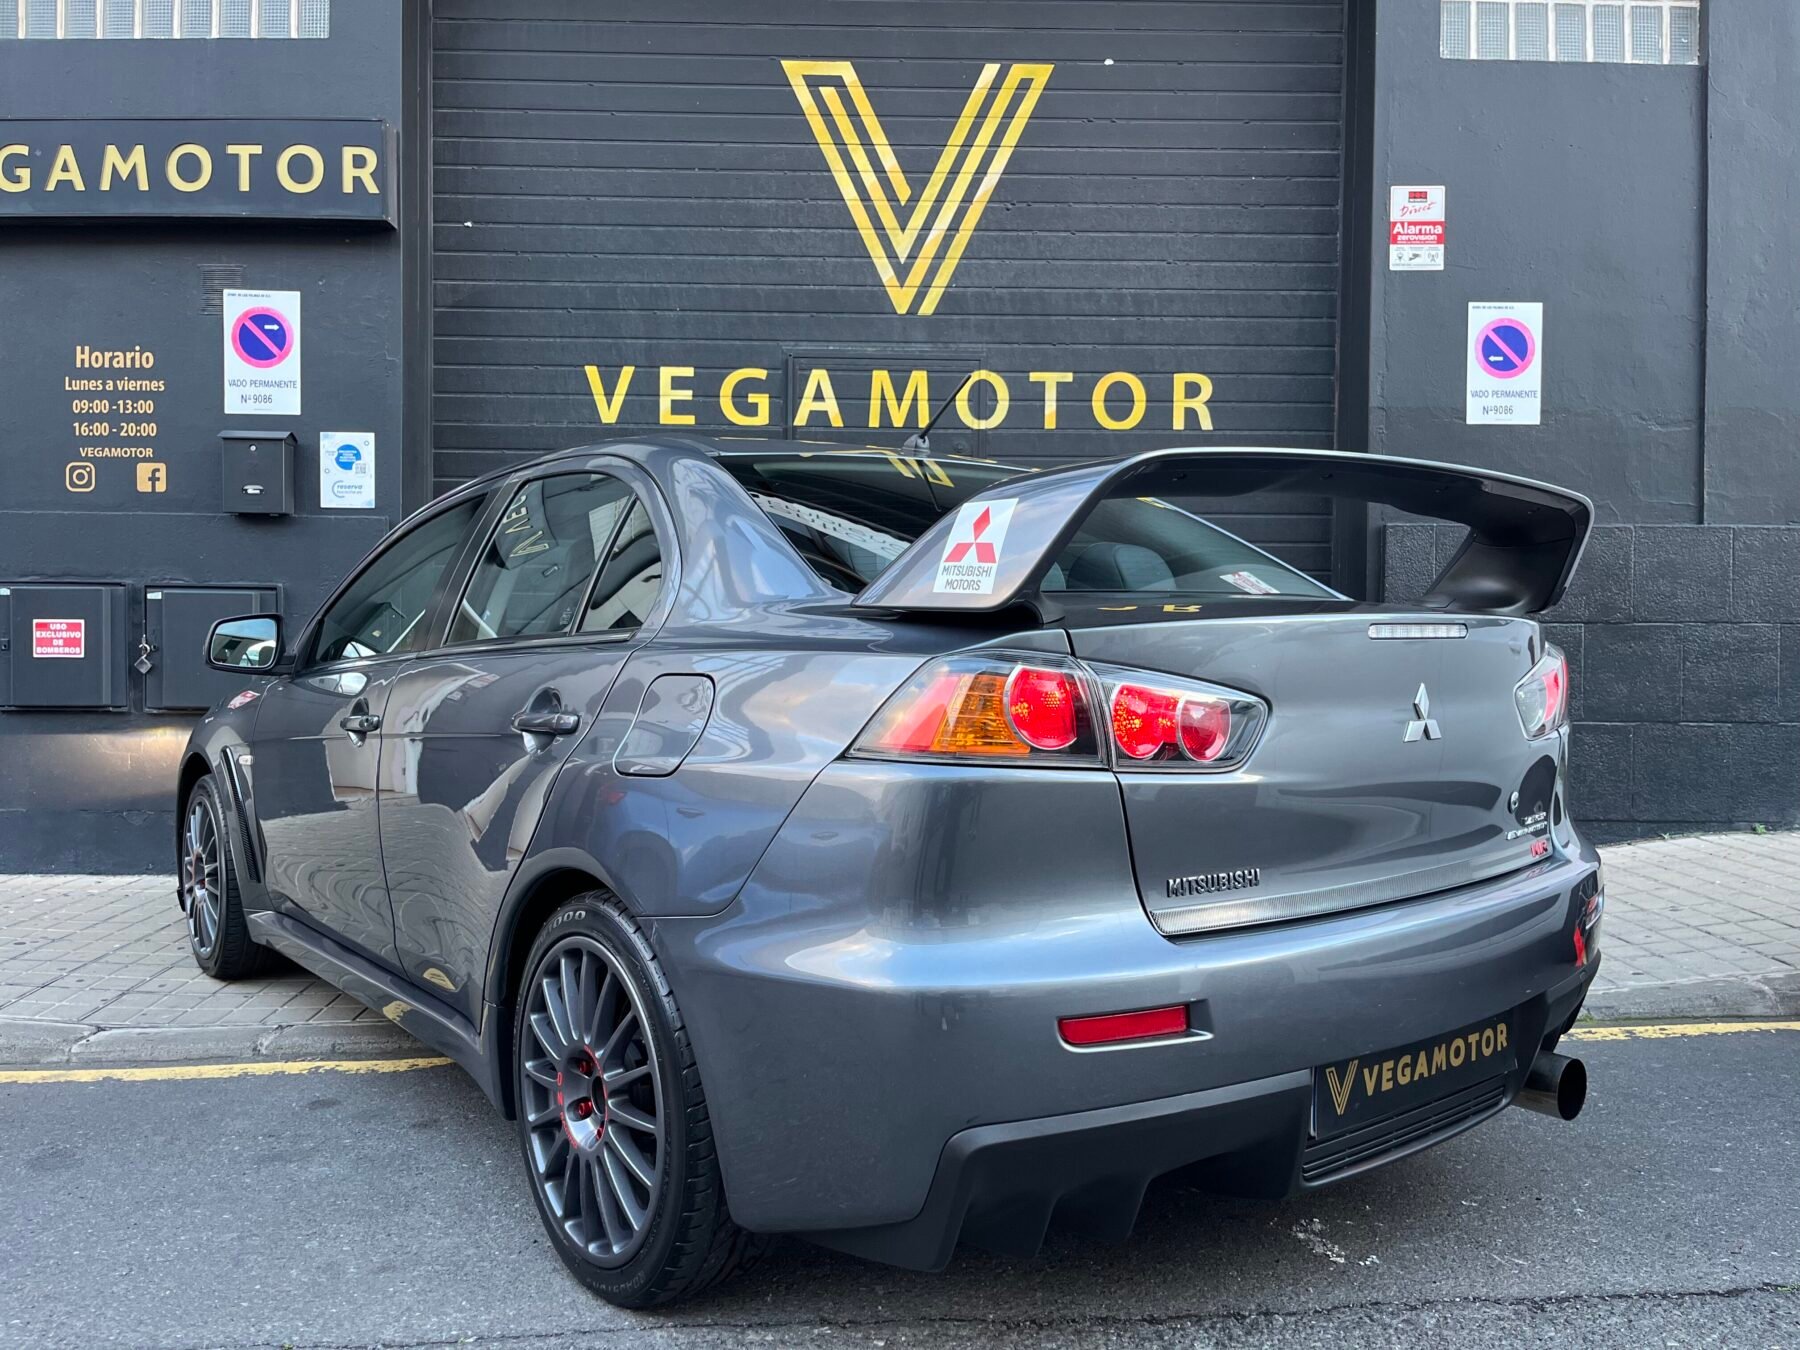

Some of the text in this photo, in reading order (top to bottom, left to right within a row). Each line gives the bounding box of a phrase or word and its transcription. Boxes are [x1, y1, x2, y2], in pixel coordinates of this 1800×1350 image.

[0, 143, 380, 194] GAMOTOR
[1393, 222, 1442, 235] Alarma
[76, 345, 154, 368] Horario
[65, 376, 165, 391] Lunes a viernes
[228, 379, 298, 389] VADO PERMANENTE
[584, 365, 1214, 431] VEGAMOTOR
[1471, 390, 1538, 399] VADO PERMANENTE
[72, 399, 109, 414] 09:00
[73, 422, 109, 437] 16:00
[120, 422, 157, 437] 20:00
[79, 447, 154, 458] VEGAMOTOR
[941, 565, 993, 578] MITSUBISHI
[944, 579, 981, 591] MOTORS
[1166, 868, 1260, 898] MITSUBISHI
[1363, 1022, 1508, 1097] VEGAMOTOR
